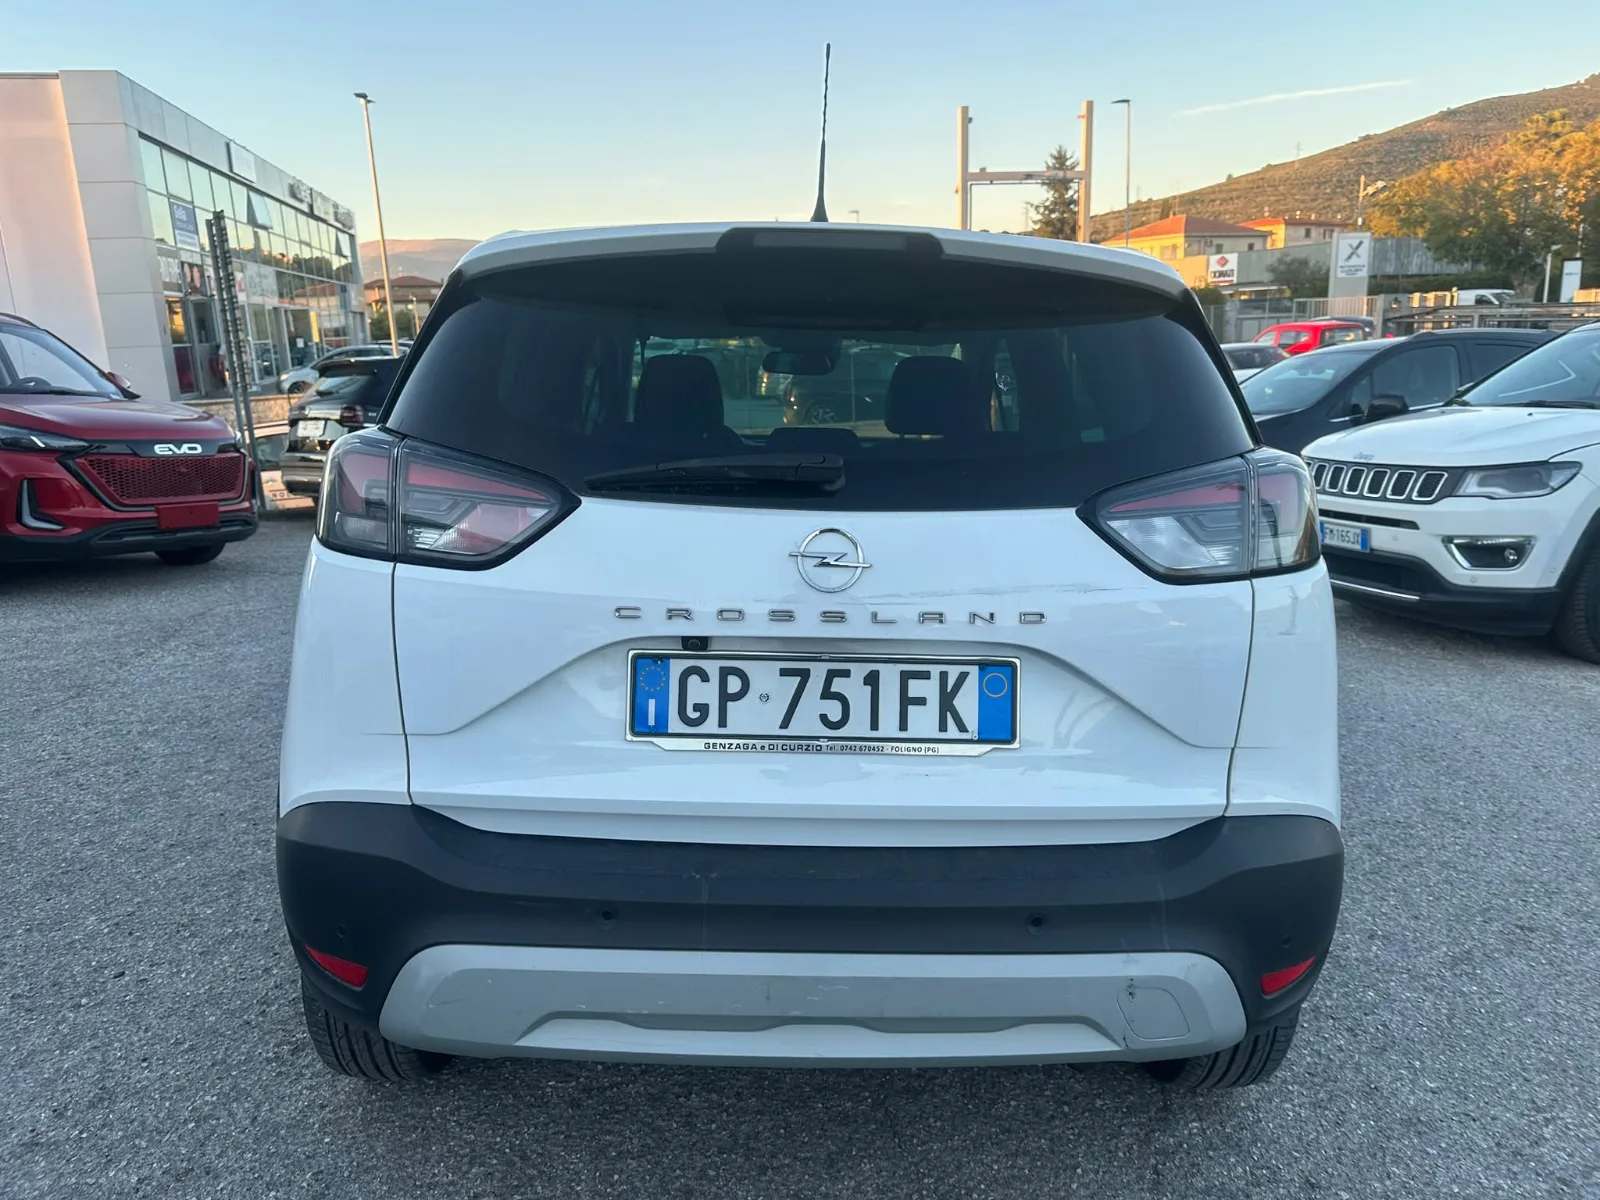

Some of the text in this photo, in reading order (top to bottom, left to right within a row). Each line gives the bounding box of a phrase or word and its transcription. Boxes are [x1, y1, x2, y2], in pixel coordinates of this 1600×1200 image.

[154, 443, 202, 455] EVO
[614, 605, 1048, 625] CROSSLAND
[677, 665, 970, 733] GP 751FK
[703, 742, 758, 751] GENZAGA
[768, 743, 780, 752] DI
[781, 743, 823, 752] CURZIO
[825, 744, 838, 752] Tel.
[840, 744, 857, 752] 0742
[858, 745, 885, 753] 670452
[924, 746, 940, 755] (PG)
